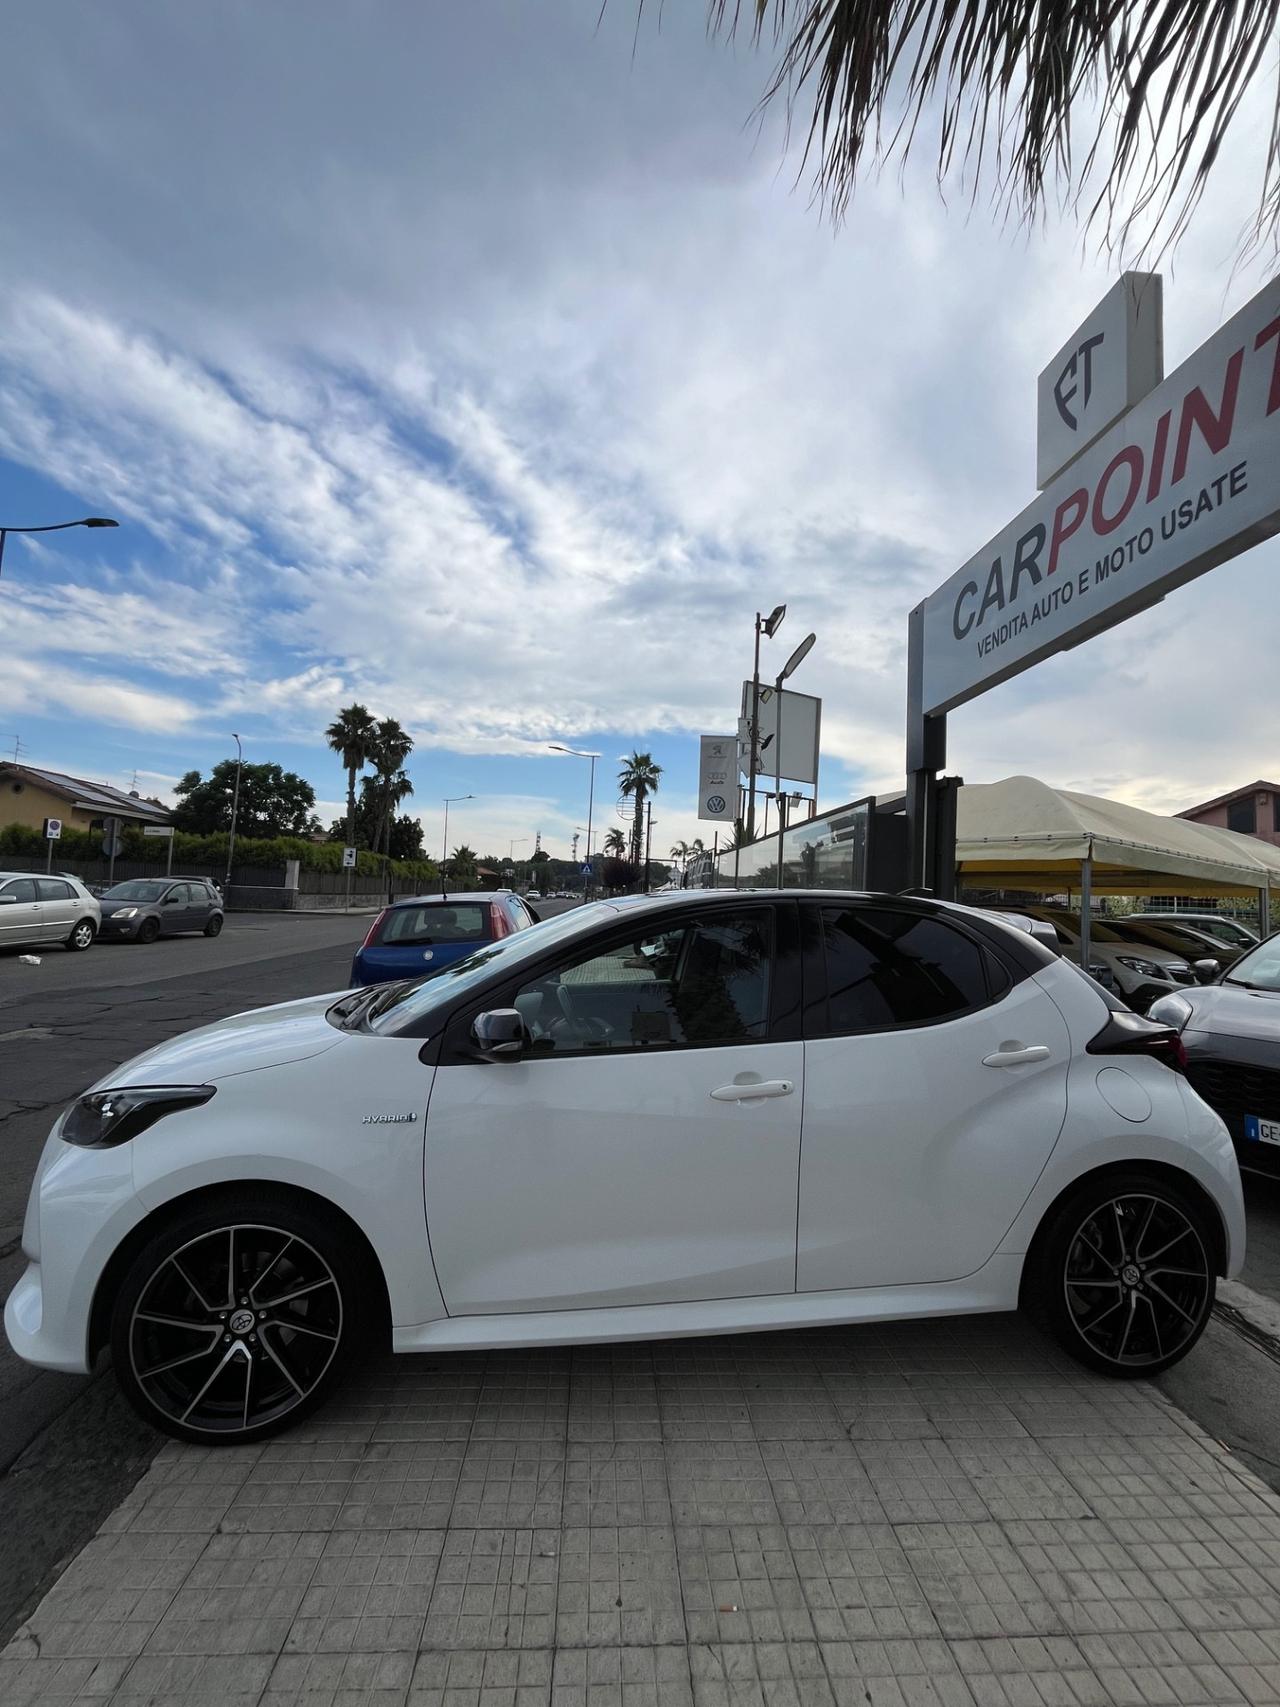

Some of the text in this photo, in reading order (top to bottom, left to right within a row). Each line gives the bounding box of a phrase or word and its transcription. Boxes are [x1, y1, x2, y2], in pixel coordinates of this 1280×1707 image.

[977, 460, 1248, 658] VENDITA AUTO E MOTO USATE
[362, 1114, 409, 1124] HYBRID
[1260, 1124, 1280, 1141] GE
